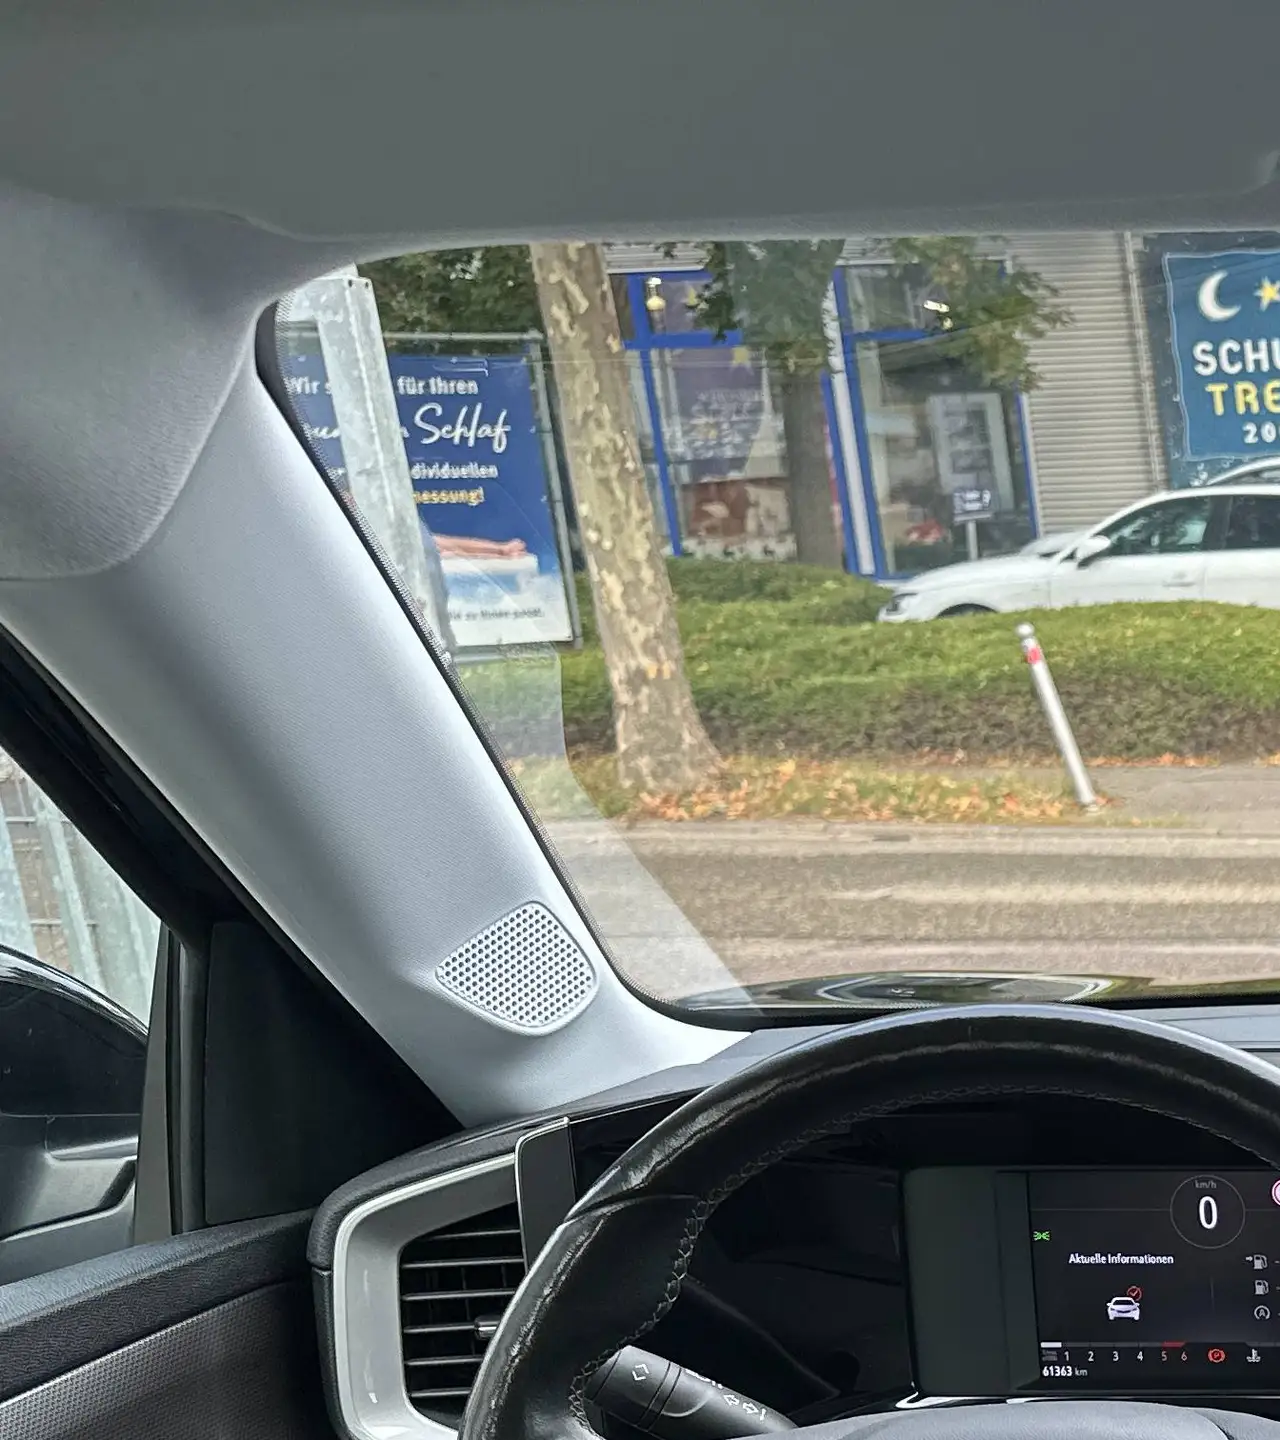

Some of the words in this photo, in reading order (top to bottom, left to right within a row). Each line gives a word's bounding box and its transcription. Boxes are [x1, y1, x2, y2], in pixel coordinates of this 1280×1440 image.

[397, 376, 423, 395] für
[429, 375, 479, 395] Ihren
[414, 402, 511, 453] Schlaf
[1195, 1180, 1217, 1189] km/h
[1198, 1195, 1218, 1230] 0
[1068, 1253, 1106, 1264] Aktuelle
[1108, 1253, 1174, 1264] Informationen
[1064, 1351, 1070, 1362] 1
[1087, 1351, 1095, 1362] 2
[1112, 1351, 1120, 1362] 3
[1136, 1351, 1144, 1362] 4
[1161, 1351, 1168, 1362] 5
[1180, 1351, 1188, 1362] 6
[1042, 1366, 1073, 1377] 61363
[1074, 1367, 1088, 1377] km
